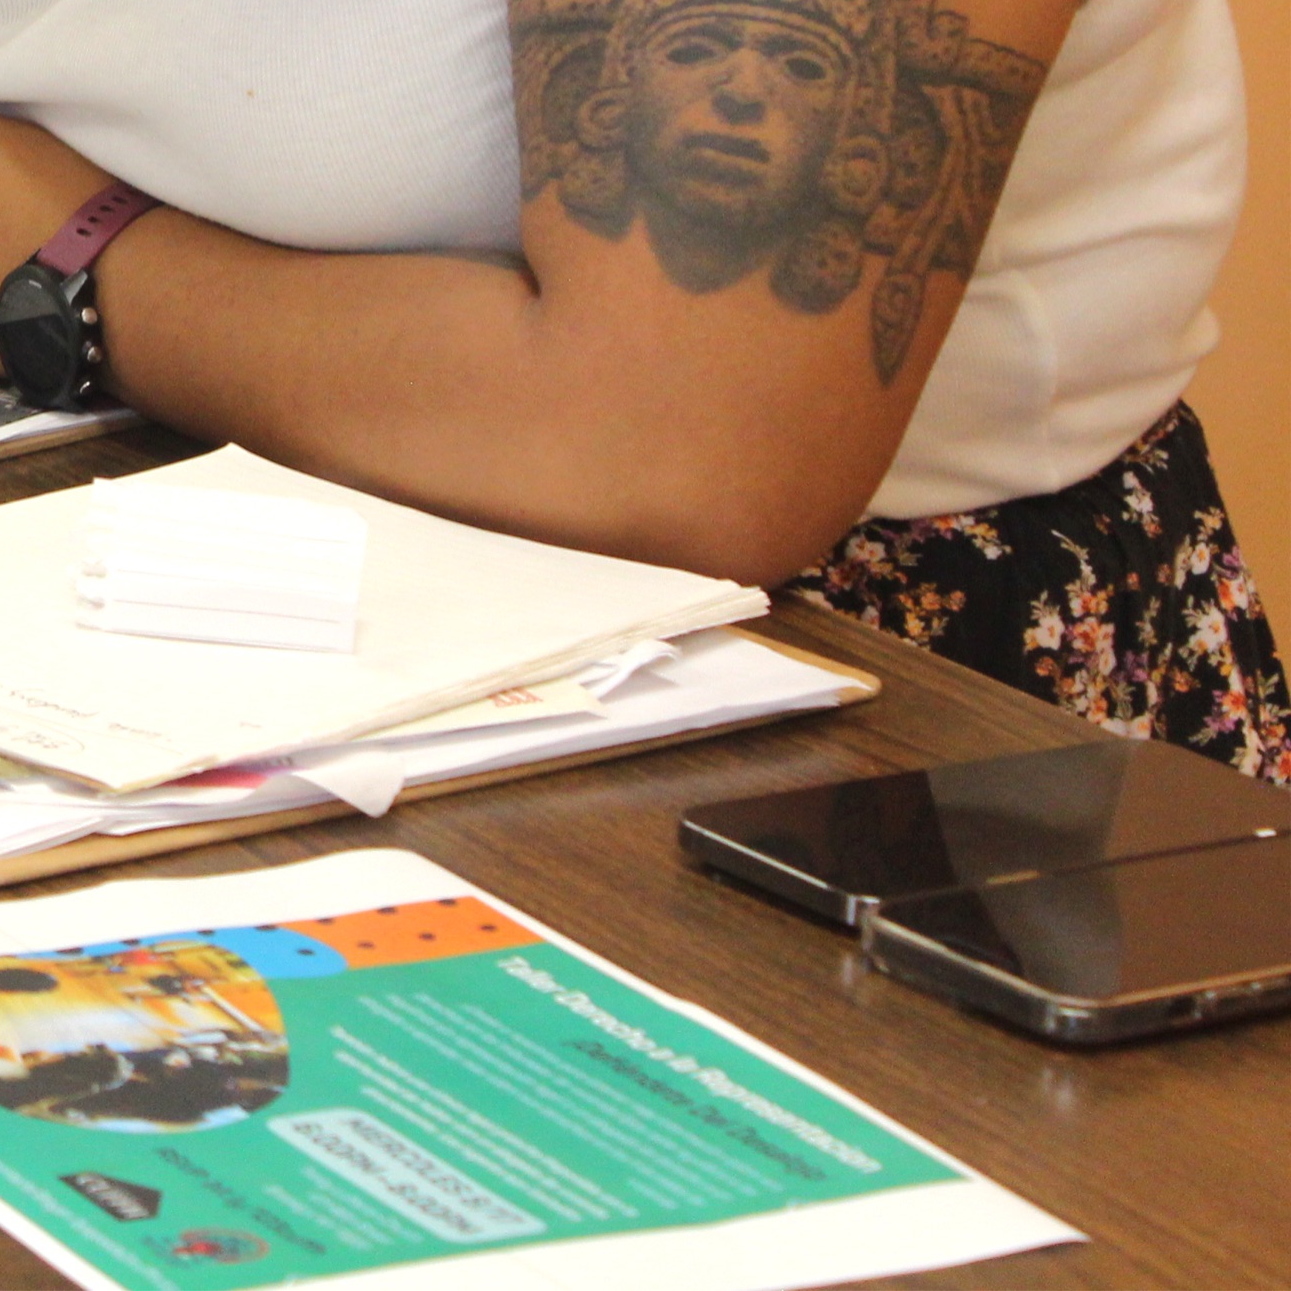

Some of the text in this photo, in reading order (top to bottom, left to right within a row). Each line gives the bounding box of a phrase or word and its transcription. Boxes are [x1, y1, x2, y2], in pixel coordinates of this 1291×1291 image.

[497, 956, 566, 994] Taller
[554, 989, 657, 1053] Derecho
[667, 1055, 699, 1074] la
